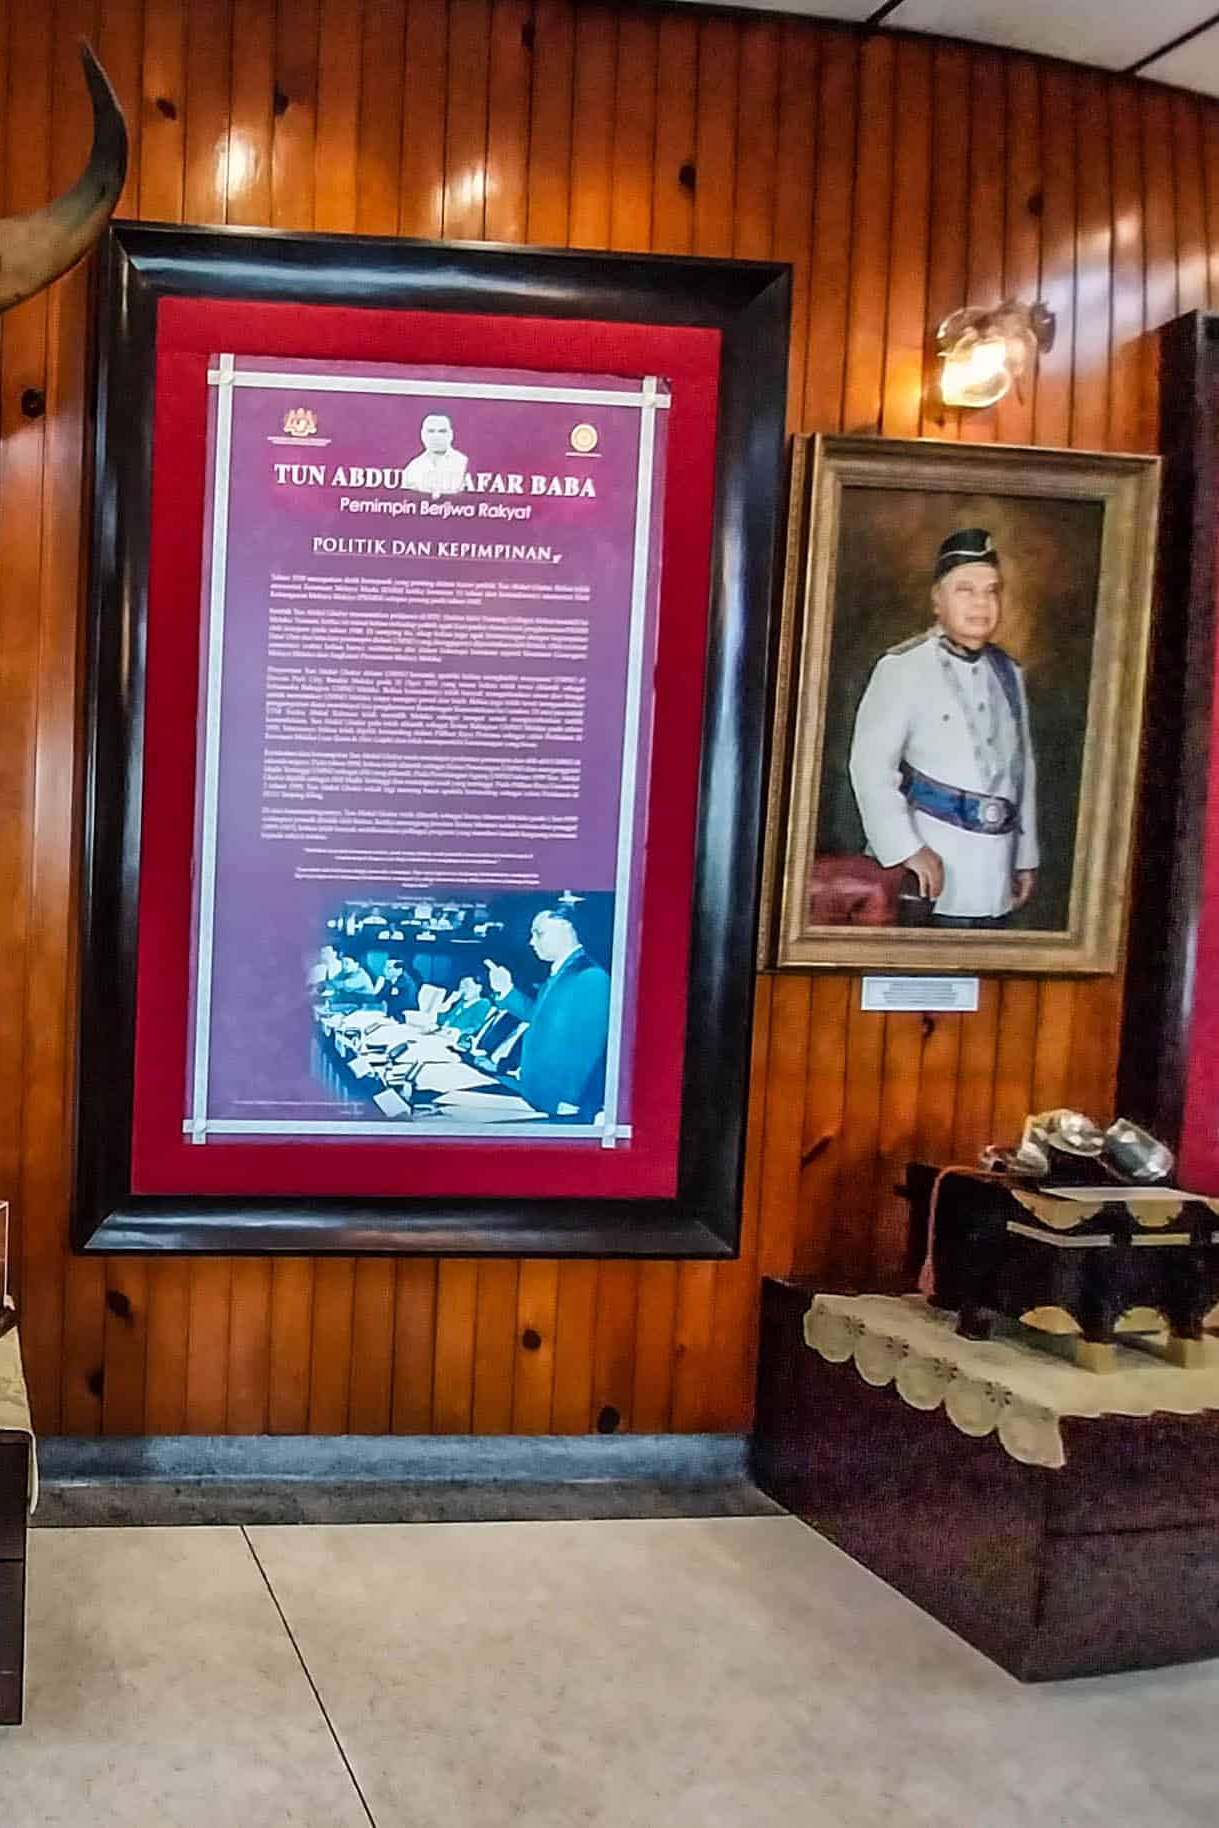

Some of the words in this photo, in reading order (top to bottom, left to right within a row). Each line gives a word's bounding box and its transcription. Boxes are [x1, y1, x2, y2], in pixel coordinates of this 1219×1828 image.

[273, 463, 326, 486] TUN
[530, 475, 597, 497] BABA
[340, 497, 416, 517] Pemimpin
[419, 501, 476, 519] Berjiwa
[478, 502, 532, 521] Rakyat
[312, 536, 387, 554] POLITIK
[392, 540, 432, 556] DAN
[437, 541, 552, 560] KEPIMPINAN
